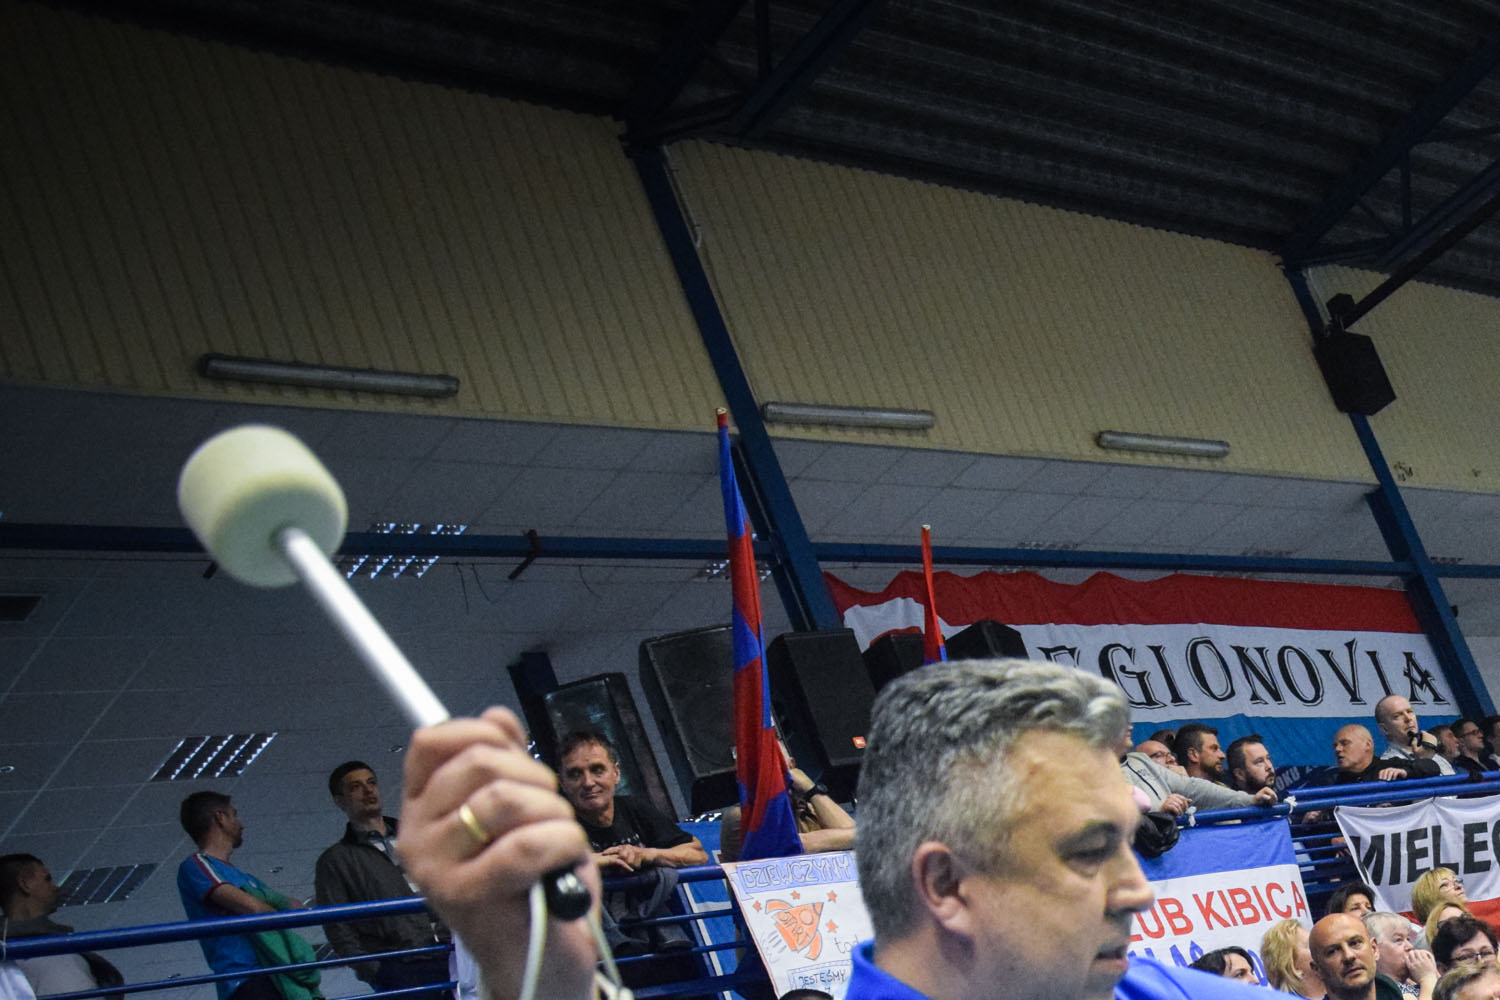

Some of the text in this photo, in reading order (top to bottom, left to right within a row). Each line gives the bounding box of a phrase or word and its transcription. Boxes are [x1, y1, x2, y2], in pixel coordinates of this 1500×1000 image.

[741, 855, 850, 889] DZIEWCZYNY
[1129, 880, 1308, 943] UB KIBICA
[797, 968, 847, 986] JESTEŚMY
